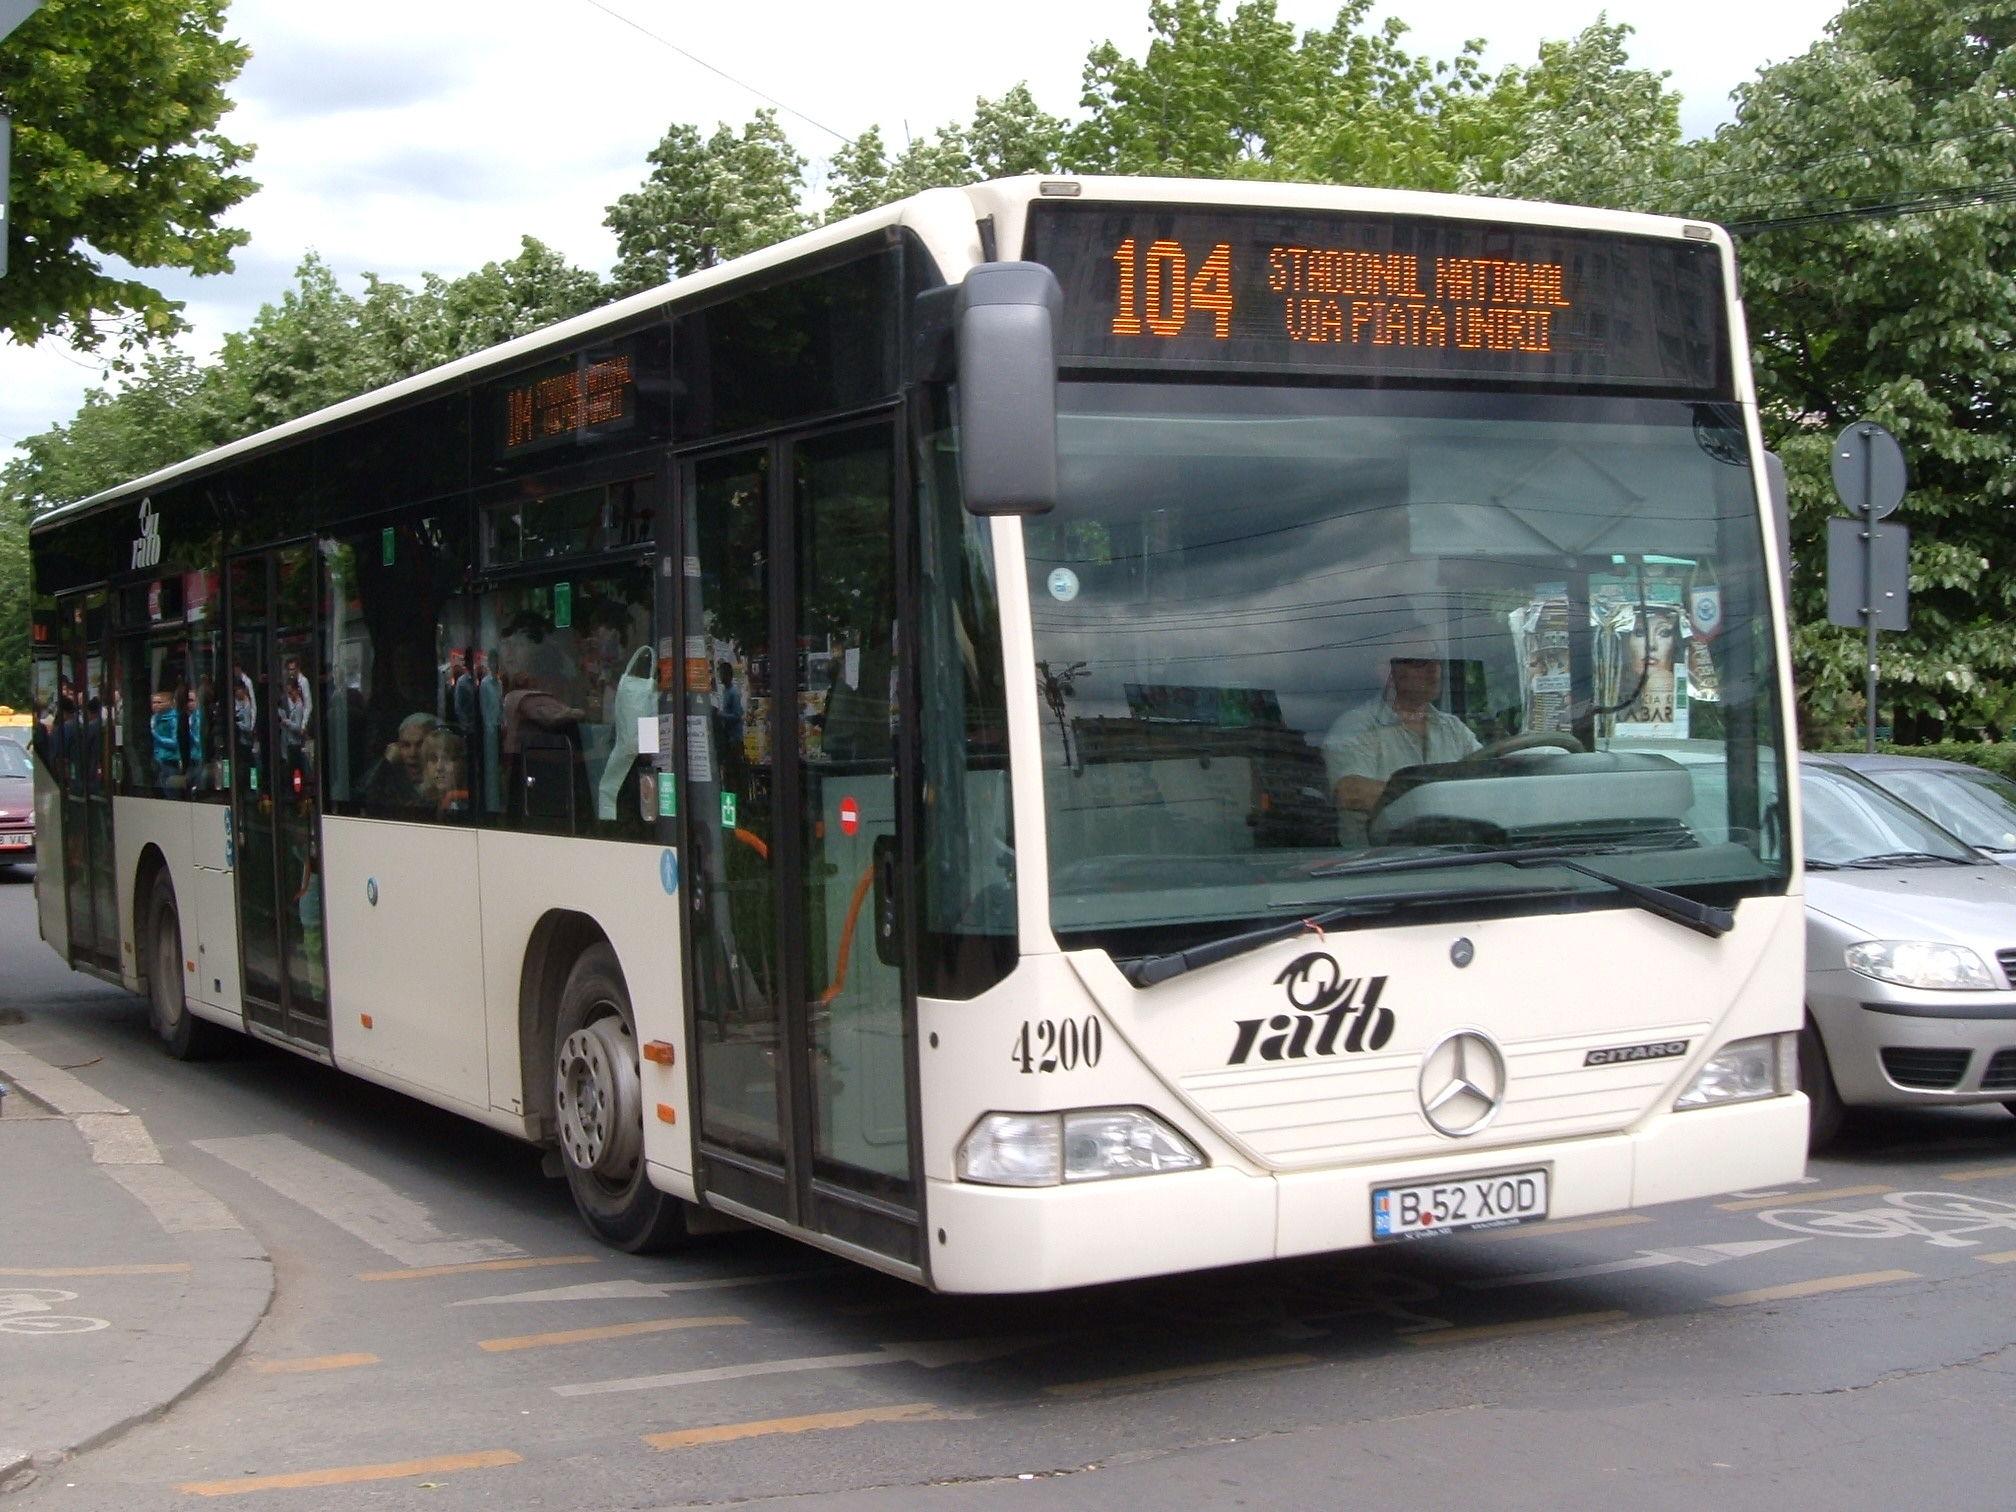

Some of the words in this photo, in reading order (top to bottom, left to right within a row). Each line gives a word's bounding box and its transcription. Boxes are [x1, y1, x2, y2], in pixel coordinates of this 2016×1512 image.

[1112, 238, 1233, 338] 104
[1269, 247, 1427, 298] STADIONUL
[1435, 256, 1571, 306] NATIONAL
[1286, 298, 1342, 343] VIA
[1352, 301, 1446, 347] PIATA
[1011, 1014, 1103, 1074] 4200
[1227, 975, 1395, 1065] ratb
[1587, 1041, 1686, 1064] CITARO
[1476, 1178, 1535, 1218] XOD
